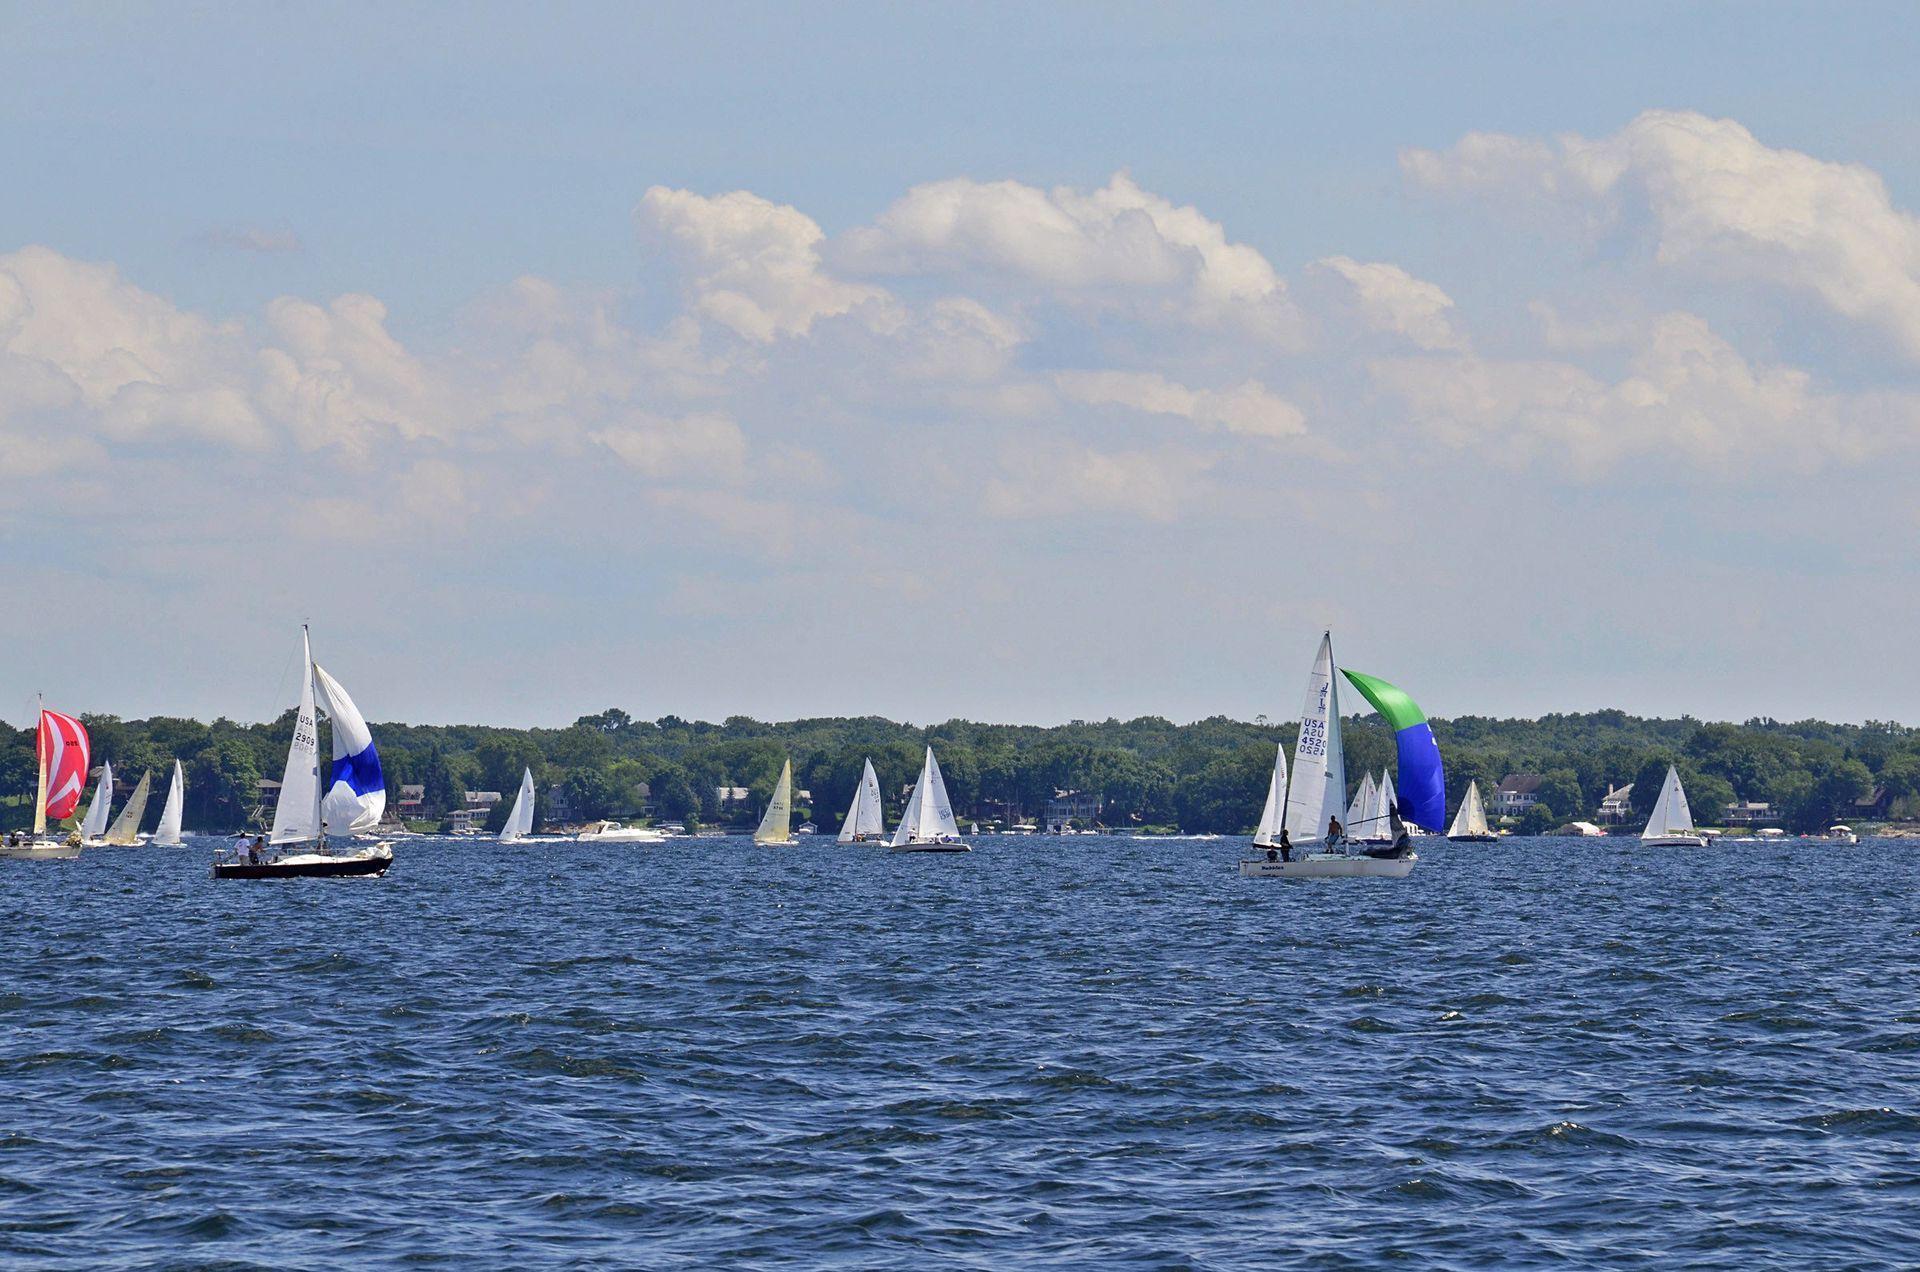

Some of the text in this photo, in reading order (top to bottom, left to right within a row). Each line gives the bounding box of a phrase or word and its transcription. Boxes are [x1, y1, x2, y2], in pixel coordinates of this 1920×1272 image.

[300, 714, 313, 728] USA
[1304, 718, 1325, 729] USA
[295, 732, 315, 747] 2909
[1301, 736, 1327, 749] 4520
